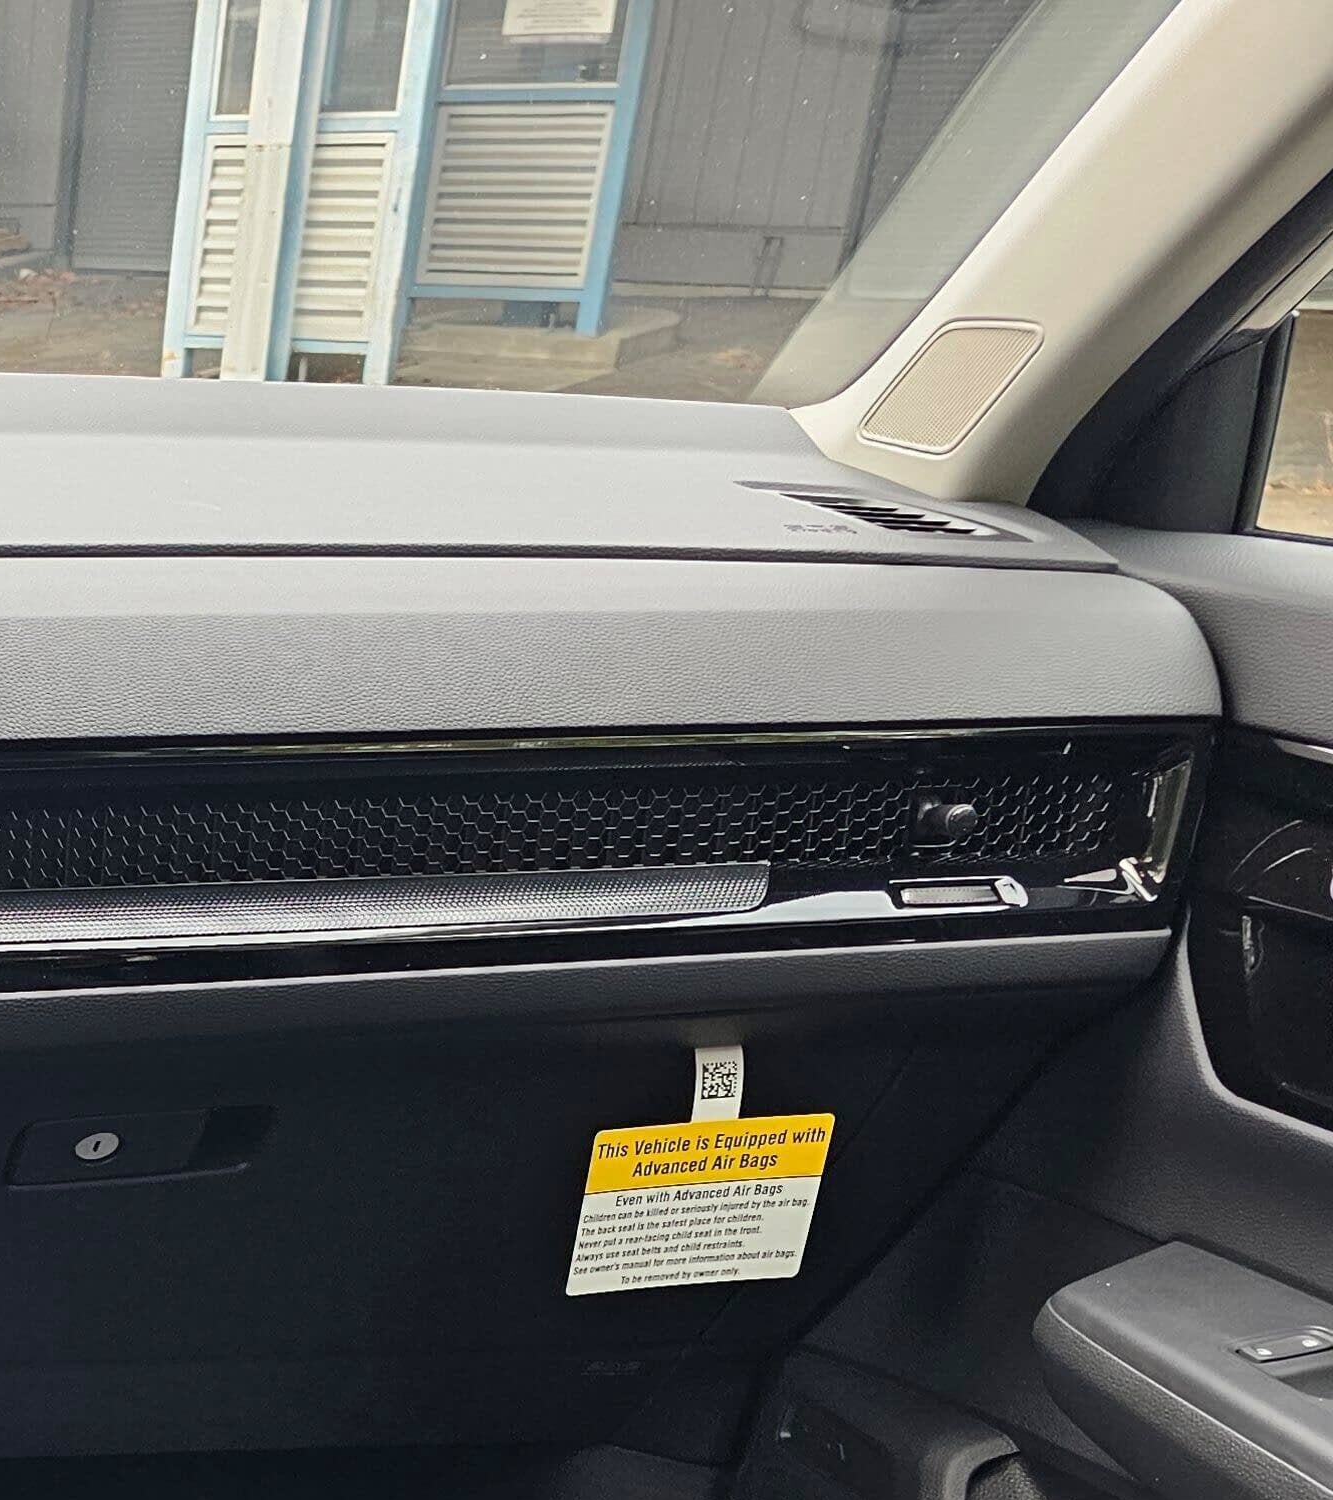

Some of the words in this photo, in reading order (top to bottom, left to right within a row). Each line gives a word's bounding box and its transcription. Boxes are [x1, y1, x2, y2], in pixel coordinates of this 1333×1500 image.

[597, 1142, 629, 1159] This
[635, 1136, 691, 1155] Vehicle
[696, 1135, 710, 1150] is
[714, 1129, 788, 1151] Equipped
[792, 1127, 826, 1144] with
[632, 1156, 708, 1178] Advanced
[711, 1154, 736, 1170] Air
[739, 1153, 778, 1170] Bags
[615, 1195, 643, 1207] Even
[647, 1191, 670, 1204] with
[673, 1186, 730, 1202] Advanced
[733, 1184, 752, 1197] Air
[754, 1184, 783, 1197] Bags
[583, 1212, 616, 1224] Children
[618, 1211, 632, 1220] can
[634, 1209, 644, 1219] be
[646, 1207, 669, 1217] killed
[670, 1207, 679, 1215] or
[681, 1204, 719, 1215] seriously
[720, 1200, 750, 1213] injured
[751, 1200, 761, 1211] by
[762, 1199, 776, 1208] the
[777, 1198, 790, 1208] air
[578, 1240, 602, 1250] Never
[603, 1237, 617, 1248] put
[625, 1233, 670, 1245] rear-facing
[672, 1230, 692, 1241] child
[694, 1228, 712, 1239] seat
[713, 1227, 723, 1237] in
[724, 1226, 738, 1236] the
[739, 1225, 762, 1235] front.
[581, 1227, 595, 1237] The
[597, 1225, 616, 1235] back
[618, 1223, 636, 1233] seat
[637, 1222, 645, 1231] is
[646, 1221, 660, 1230] the
[661, 1218, 687, 1229] safest
[689, 1217, 711, 1228] place
[713, 1215, 726, 1225] for
[727, 1213, 765, 1223] children.
[573, 1266, 588, 1275] See
[589, 1263, 620, 1274] owner's
[621, 1258, 652, 1270] manual
[653, 1257, 664, 1267] for
[666, 1256, 687, 1265] more
[688, 1252, 734, 1264] information
[736, 1250, 760, 1260] about
[761, 1249, 774, 1259] air
[575, 1252, 603, 1263] Always
[606, 1251, 620, 1259] use
[622, 1247, 639, 1257] seat
[641, 1246, 661, 1256] belts
[663, 1244, 679, 1253] and
[680, 1242, 701, 1252] child
[621, 1276, 630, 1284] To
[631, 1275, 642, 1284] be
[644, 1271, 679, 1283] removed
[681, 1270, 691, 1280] by
[693, 1268, 719, 1278] owner
